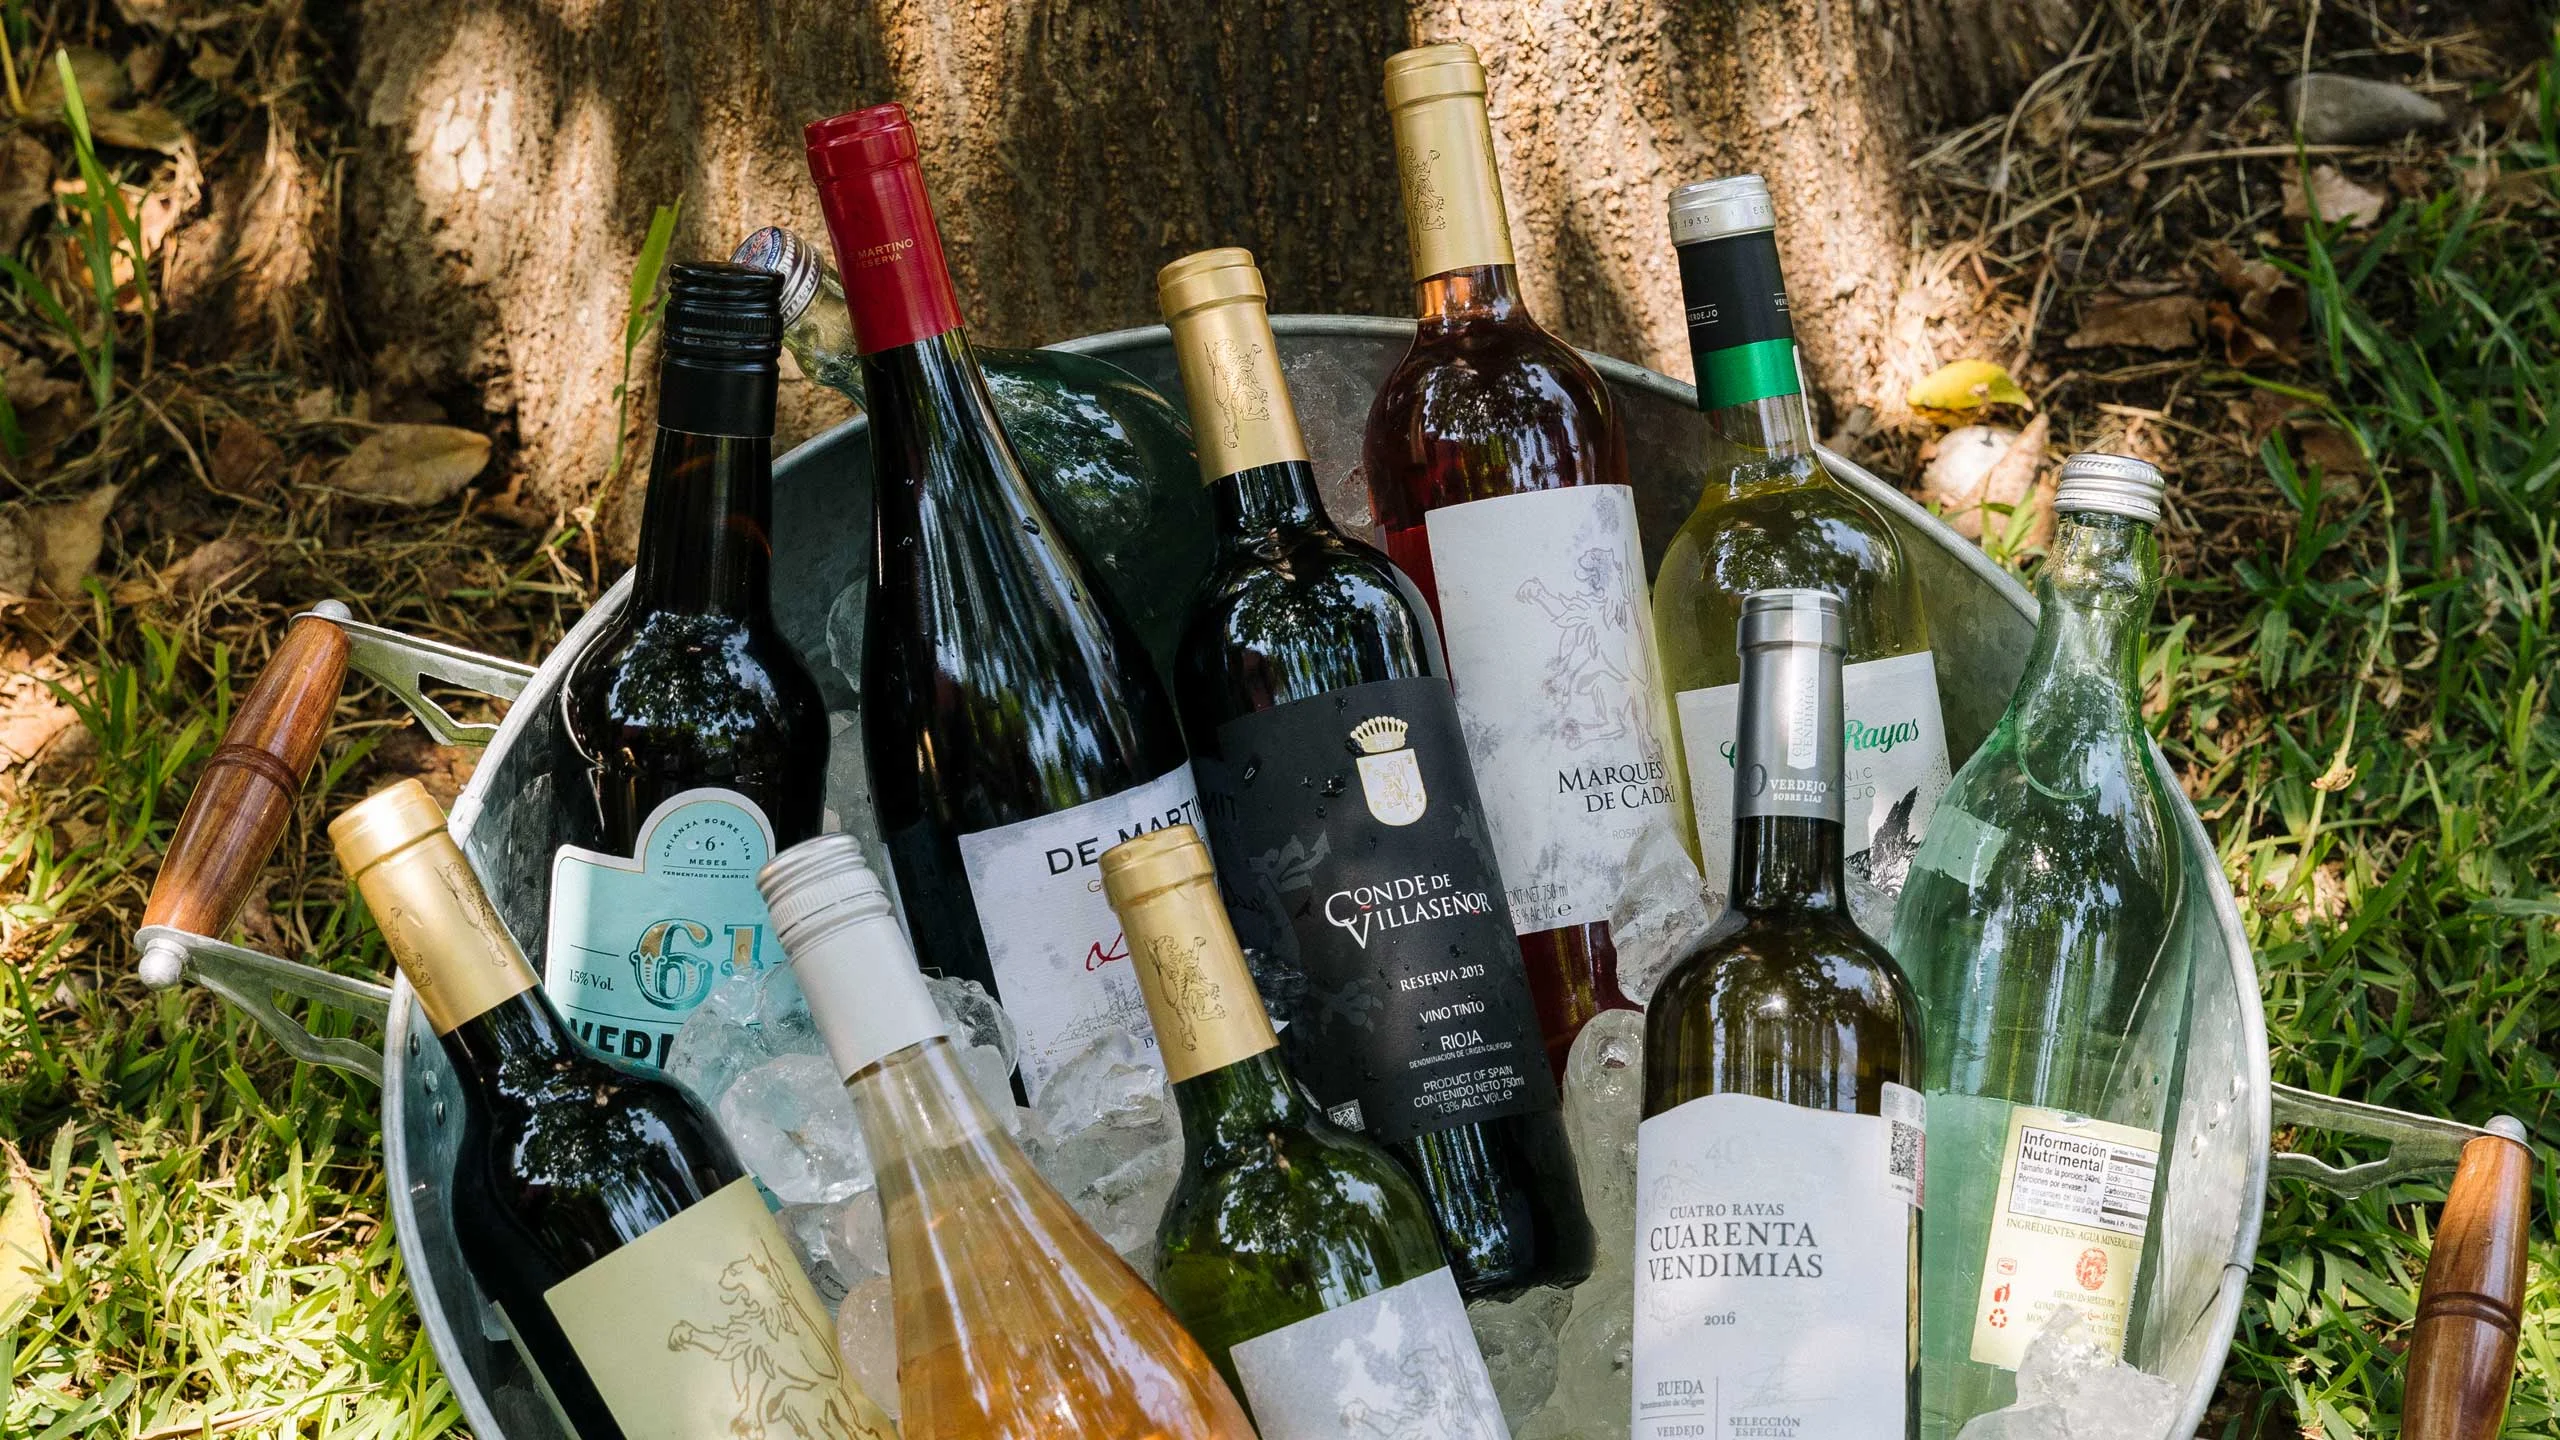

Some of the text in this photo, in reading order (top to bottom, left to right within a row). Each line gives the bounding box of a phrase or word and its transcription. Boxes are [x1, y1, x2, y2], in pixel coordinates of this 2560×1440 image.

[858, 238, 914, 259] MARTINO
[857, 253, 903, 268] ESERVA
[1844, 718, 1919, 753] Rayas
[1769, 779, 1826, 794] VERDEJO
[1584, 792, 1616, 813] DE
[664, 820, 699, 858] CRIANZA
[704, 818, 739, 834] SOBRE
[705, 835, 717, 852] 6
[1612, 827, 1641, 841] ROSA
[689, 858, 728, 867] MESES
[1045, 837, 1099, 876] DE
[663, 870, 708, 879] FERMENTADO
[1325, 873, 1453, 927] CONDE DE
[1341, 891, 1493, 949] VILLASEÑOR
[569, 968, 615, 991] 15% Vol.
[1400, 964, 1485, 992] RESERVA 2013
[1420, 1000, 1485, 1023] VINO TINTO
[1440, 1029, 1484, 1051] RIOJA
[1456, 1047, 1465, 1058] DE
[1423, 1065, 1513, 1093] PRODUCT OF SPAIN
[1413, 1085, 1474, 1108] CONTENIDO
[1475, 1079, 1501, 1093] NETO
[1438, 1100, 1460, 1114] 13%
[2024, 1131, 2107, 1158] Información
[2022, 1145, 2104, 1173] Nutrimental
[1670, 1203, 1785, 1219] CUATRO RAYAS
[1650, 1222, 1818, 1251] CUARENTA
[2078, 1231, 2101, 1243] AGUA
[1648, 1252, 1823, 1283] VENDIMIAS
[1704, 1311, 1736, 1326] 2016
[1657, 1380, 1705, 1397] RUEDA
[1657, 1425, 1705, 1438] VERDEJO
[1729, 1415, 1801, 1427] SELECCIÓN
[1735, 1428, 1797, 1438] ESPECIAL
